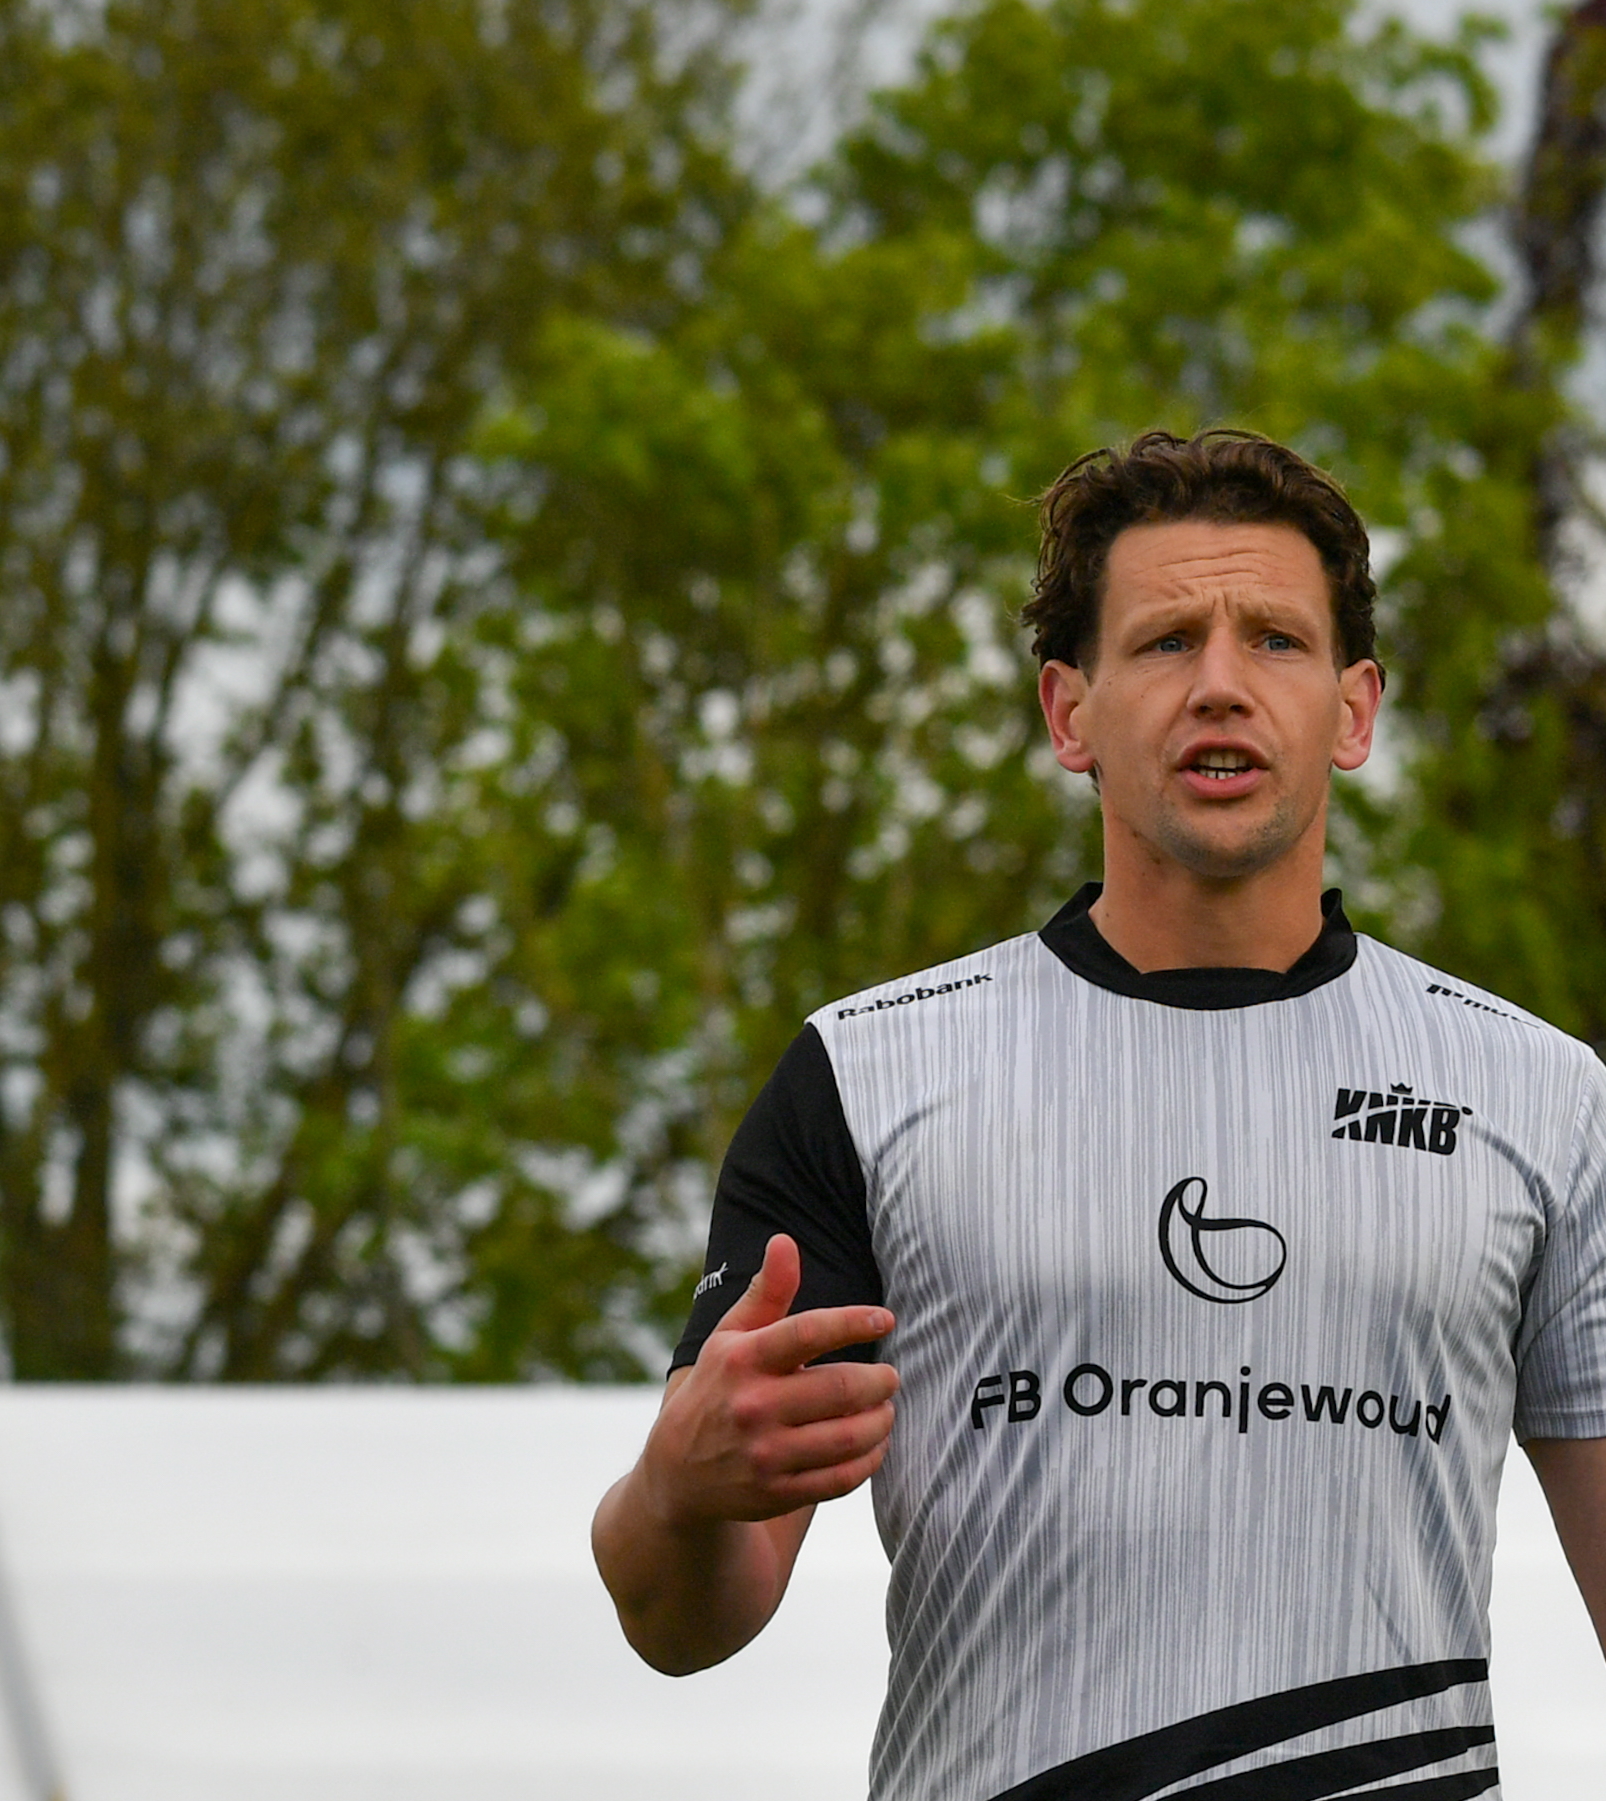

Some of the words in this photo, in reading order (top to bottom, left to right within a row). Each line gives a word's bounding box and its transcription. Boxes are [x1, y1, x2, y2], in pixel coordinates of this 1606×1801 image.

[837, 973, 994, 1021] Rabobank
[1331, 1087, 1461, 1157] KNKB
[970, 1369, 1042, 1430] FB
[1062, 1362, 1452, 1445] Oranjewoud
